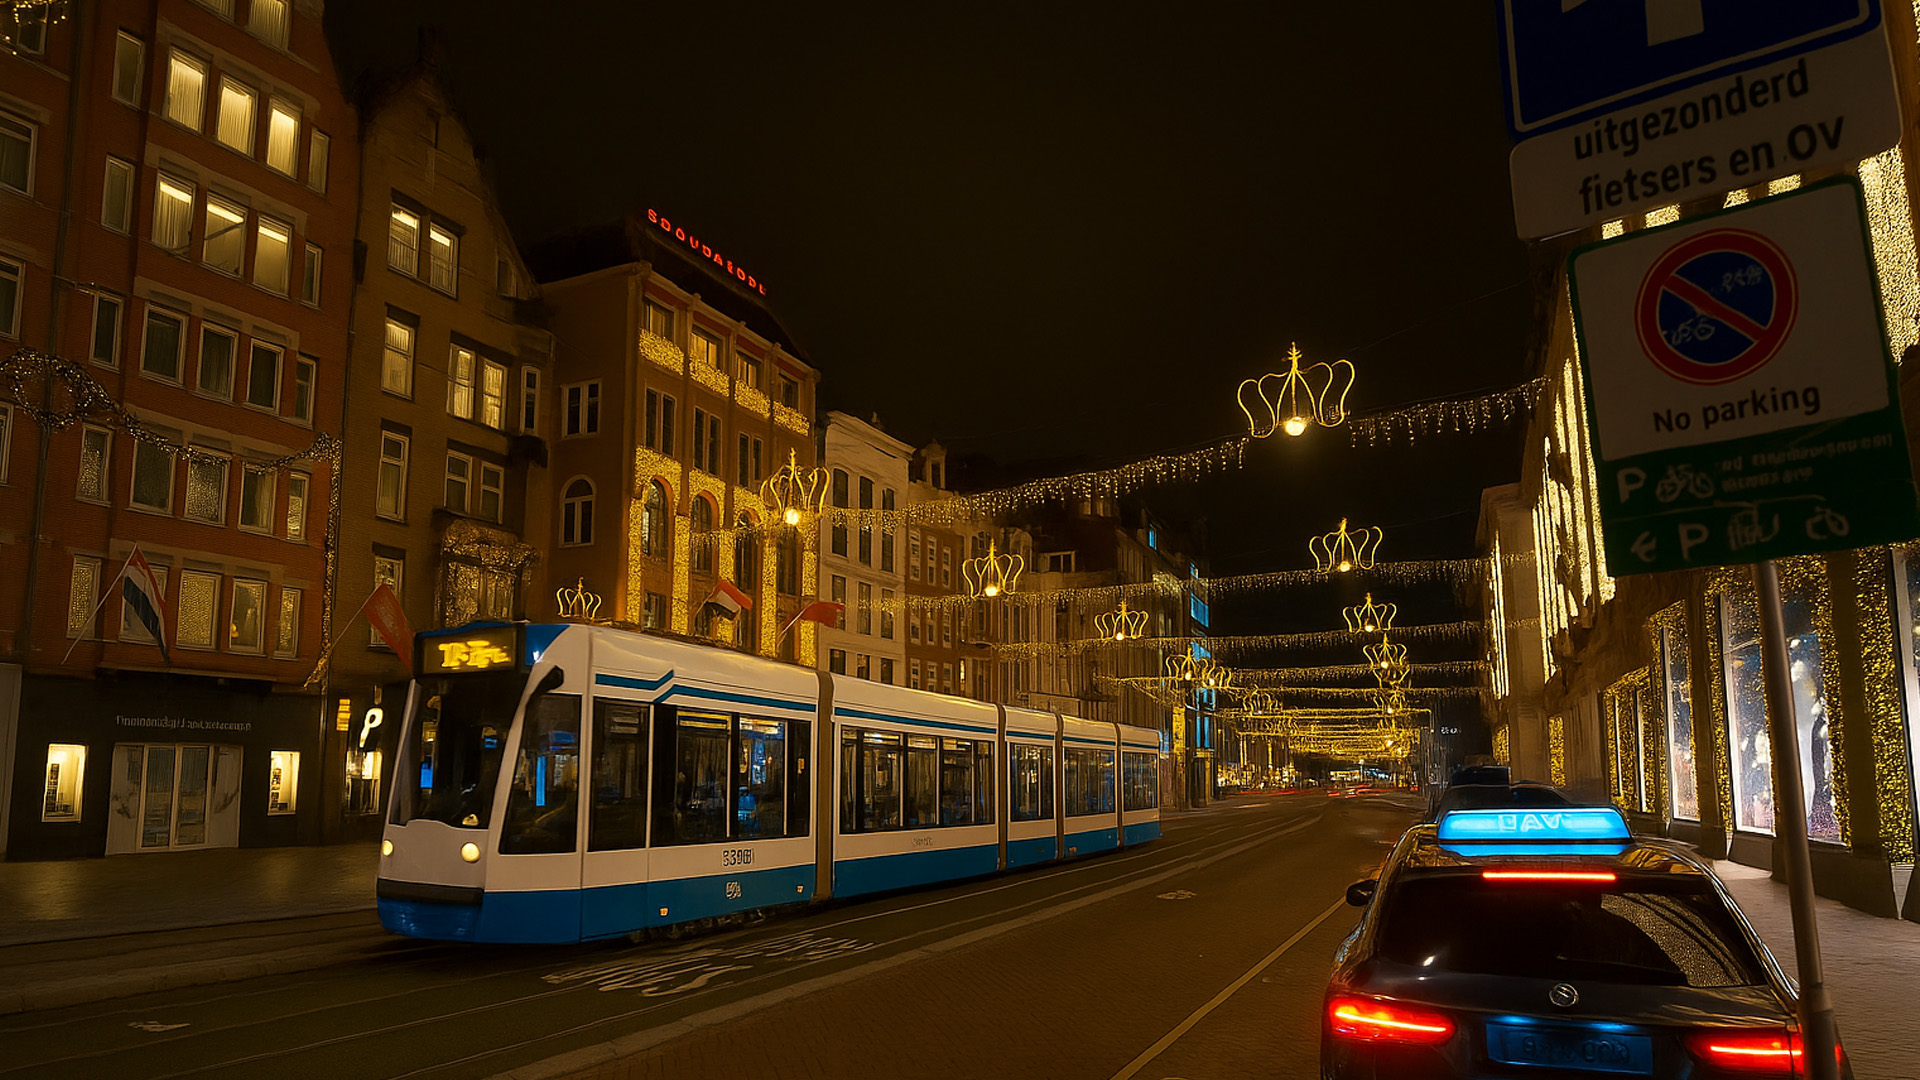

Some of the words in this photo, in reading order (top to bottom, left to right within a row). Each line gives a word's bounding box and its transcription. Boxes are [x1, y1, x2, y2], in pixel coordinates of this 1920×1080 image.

[1575, 58, 1809, 160] uitgezonderd
[1579, 155, 1717, 215] fietsers
[1730, 141, 1775, 177] en
[1787, 117, 1845, 162] OV
[1653, 409, 1691, 433] No
[1703, 387, 1821, 430] parking
[1616, 467, 1647, 504] P
[1677, 523, 1710, 561] P
